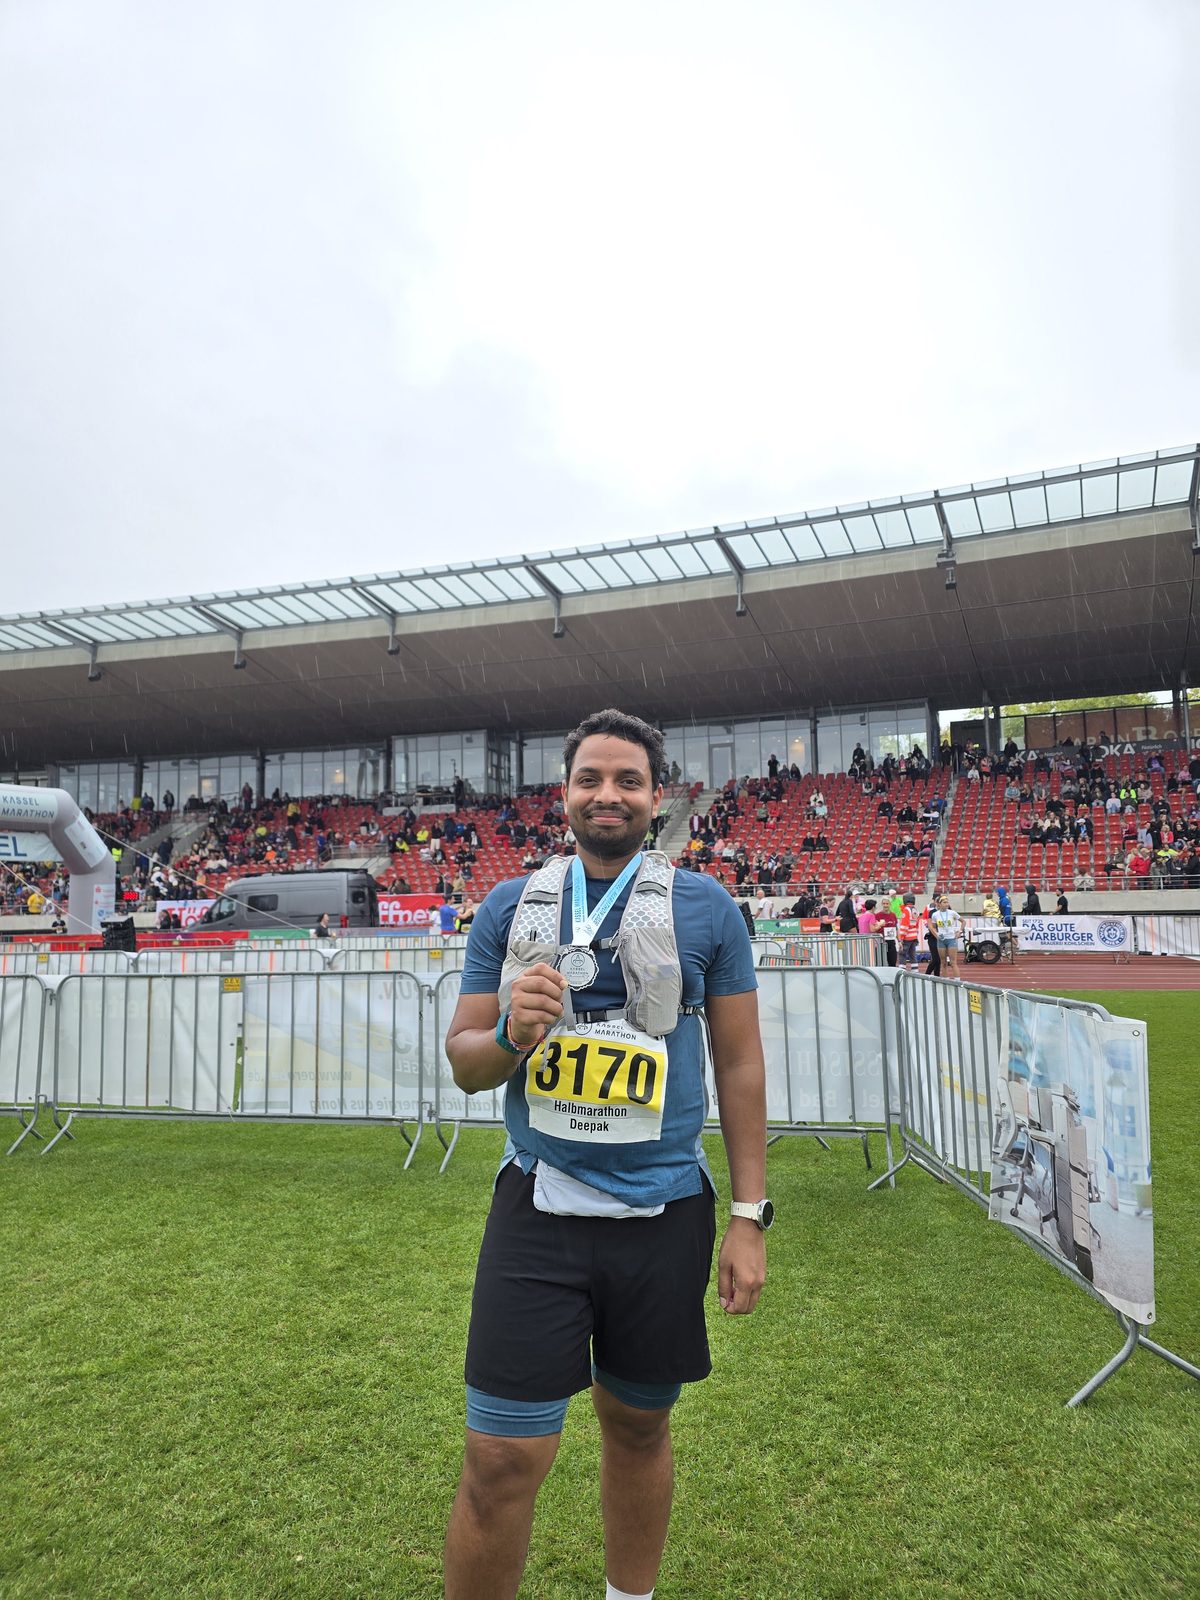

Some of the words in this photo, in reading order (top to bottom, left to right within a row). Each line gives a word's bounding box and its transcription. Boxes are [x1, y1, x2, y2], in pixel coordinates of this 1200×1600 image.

[2, 795, 40, 806] KASSEL
[1, 807, 55, 819] MARATHON
[1047, 923, 1076, 932] GUTE
[594, 1029, 637, 1041] MARATHON
[535, 1041, 657, 1105] 3170
[554, 1100, 627, 1117] Halbmarathon
[570, 1118, 609, 1134] Deepak
